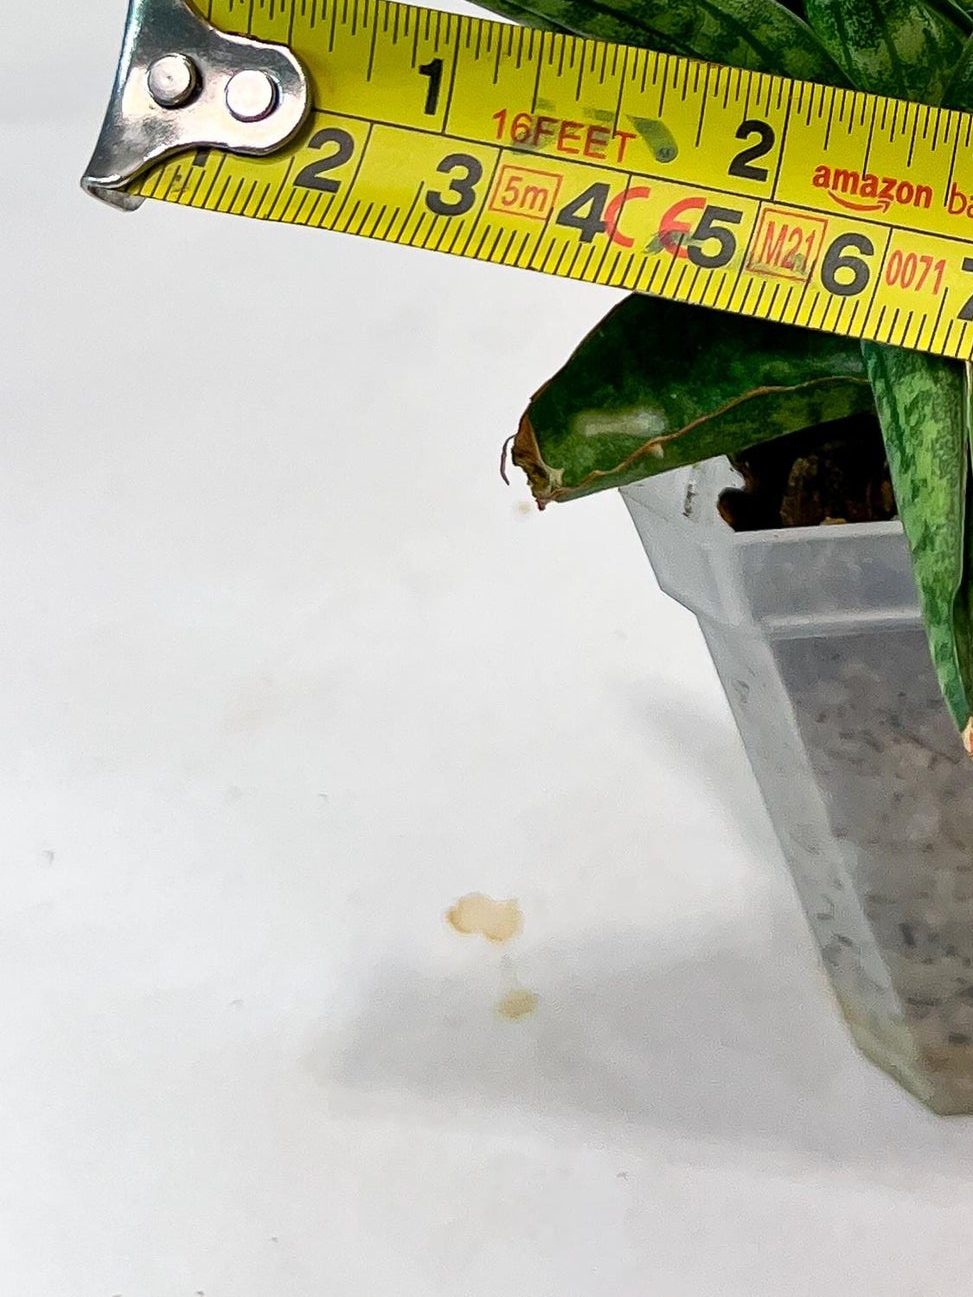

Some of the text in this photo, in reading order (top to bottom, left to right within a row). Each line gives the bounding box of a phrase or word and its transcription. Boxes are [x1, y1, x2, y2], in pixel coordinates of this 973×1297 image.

[417, 58, 444, 115] 1
[293, 128, 355, 194] 2
[728, 119, 776, 181] 2
[425, 153, 483, 216] 3
[500, 178, 549, 212] 5m
[556, 182, 607, 242] 4
[812, 164, 932, 209] amazon
[686, 204, 743, 269] 5
[761, 220, 816, 275] M21
[820, 232, 874, 297] 6
[885, 249, 946, 296] 0071
